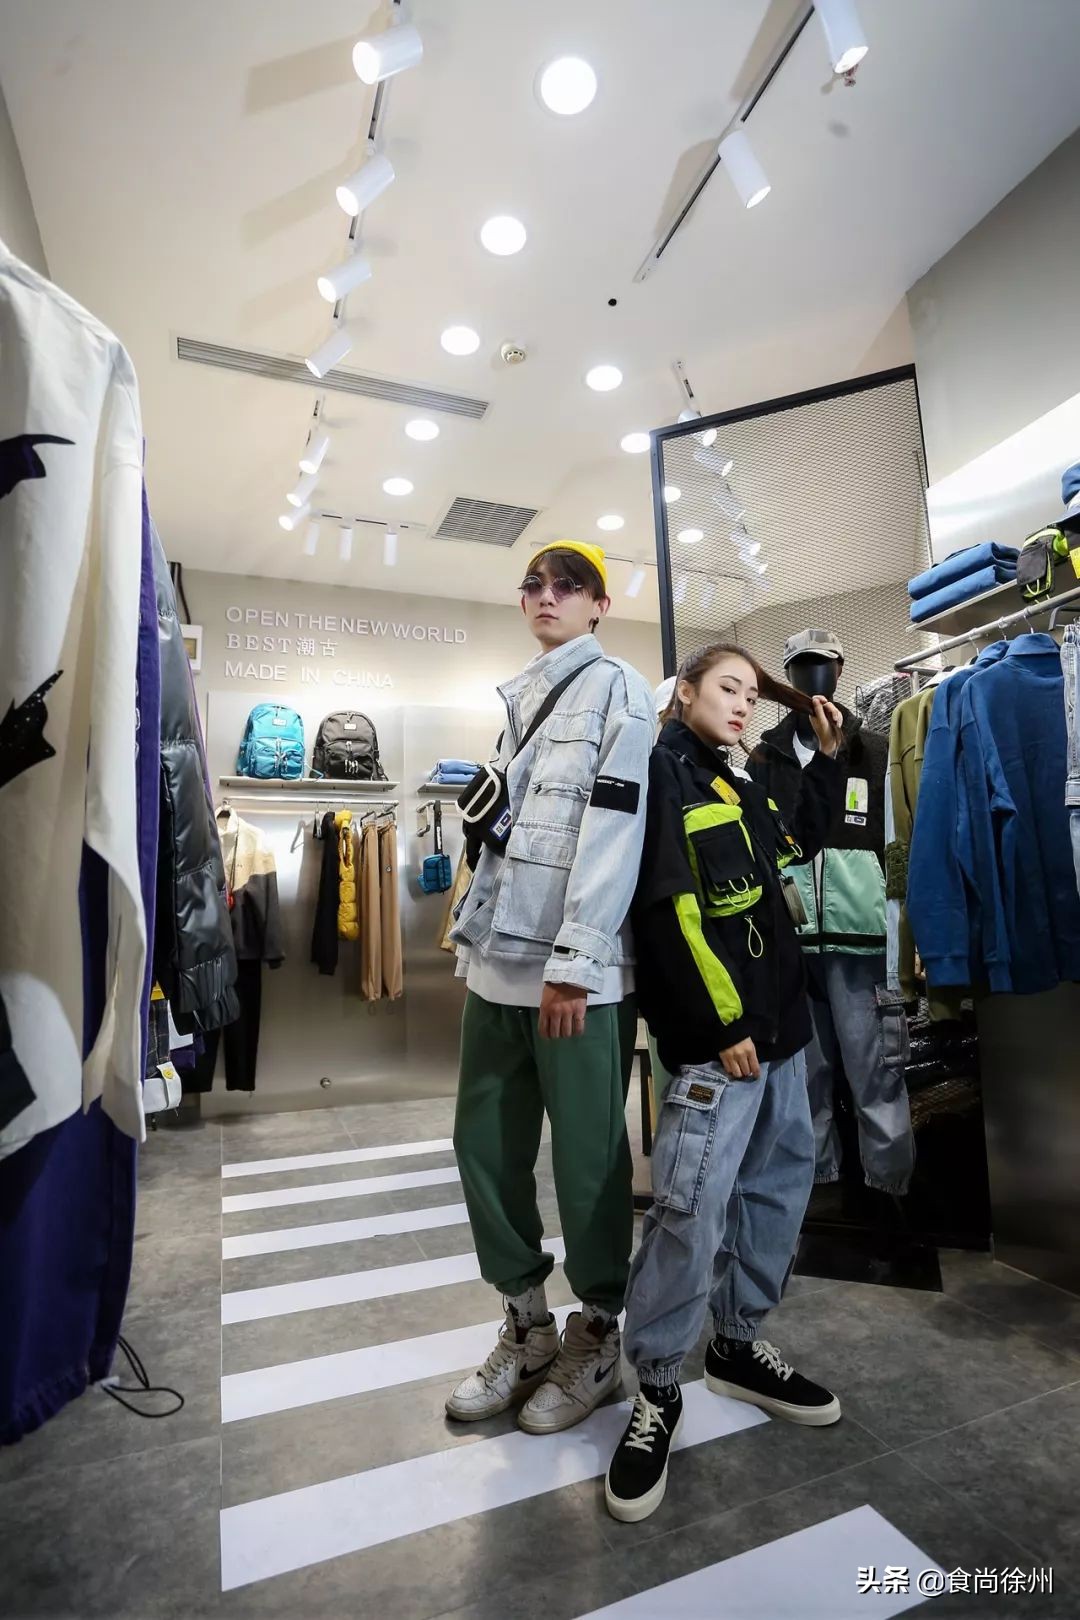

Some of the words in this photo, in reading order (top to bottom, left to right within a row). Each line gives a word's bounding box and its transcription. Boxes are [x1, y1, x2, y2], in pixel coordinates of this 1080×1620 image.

[225, 606, 289, 628] OPEN
[294, 612, 337, 632] THE
[340, 617, 390, 637] NEW
[391, 622, 467, 644] WORLD
[224, 660, 288, 681] MADE
[300, 667, 320, 685] IN
[332, 667, 394, 689] CHINA
